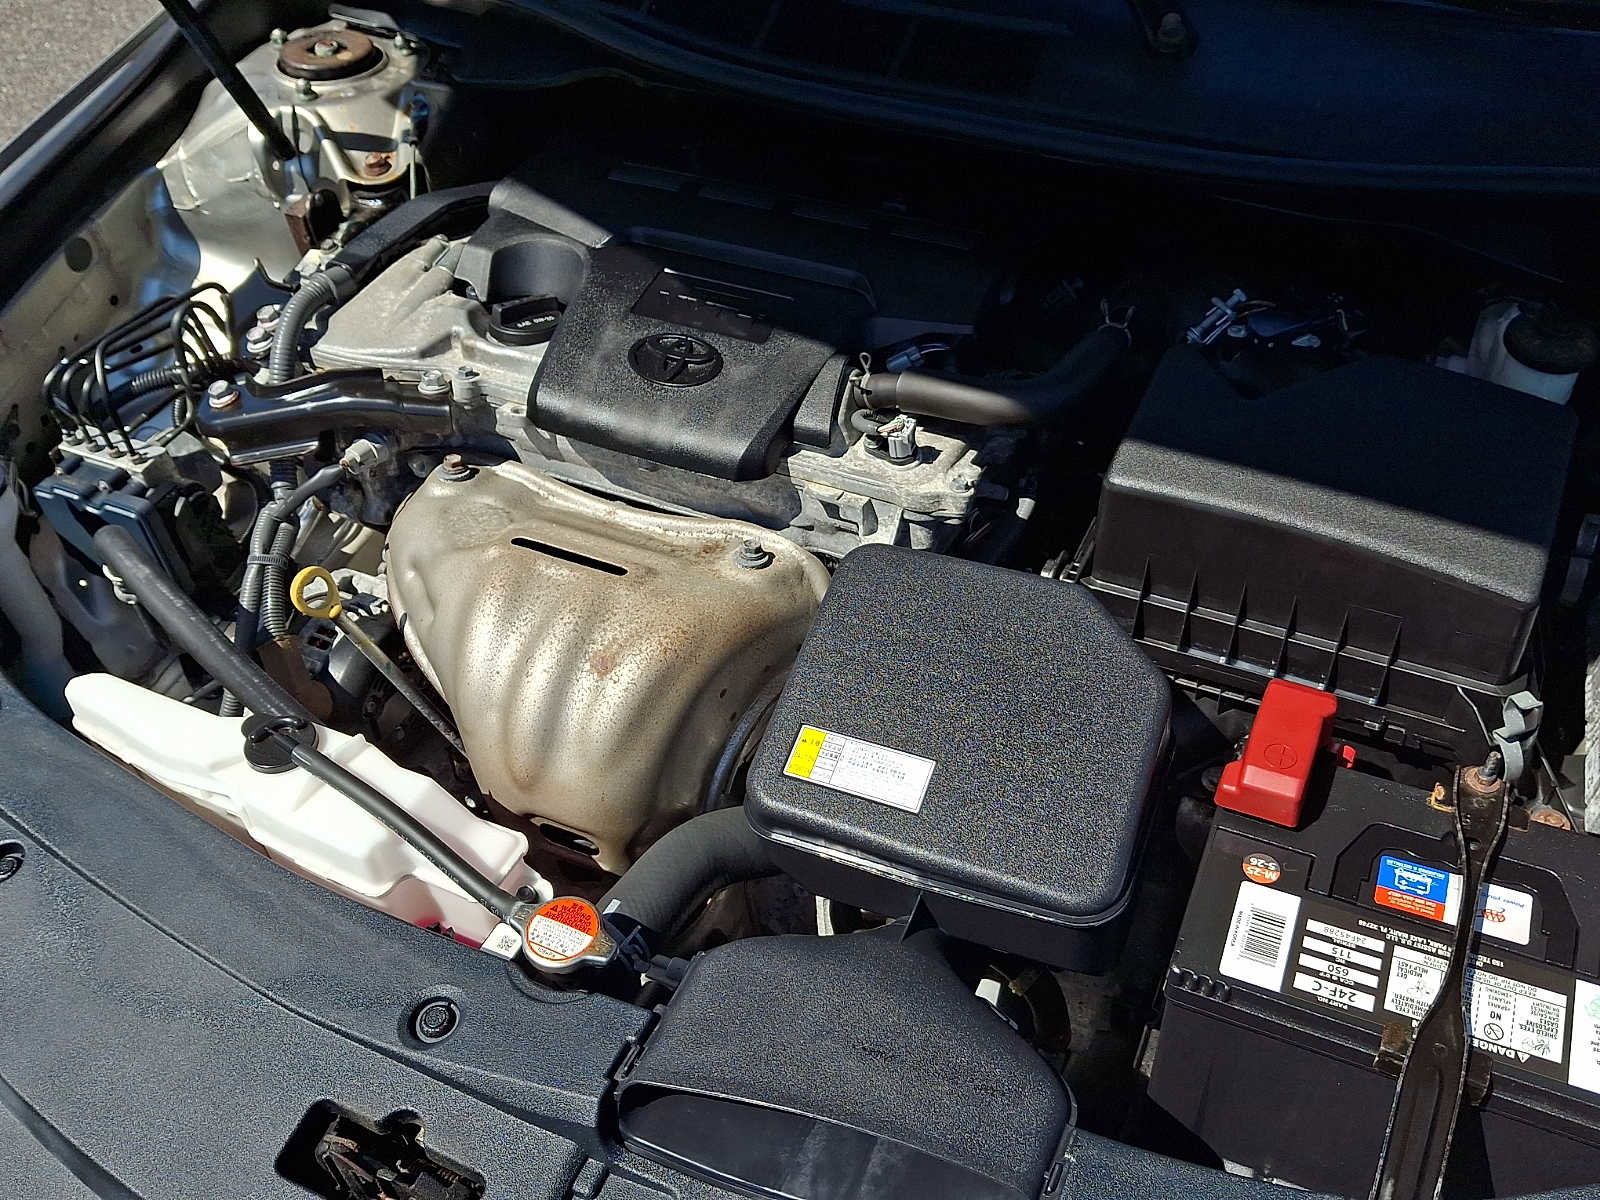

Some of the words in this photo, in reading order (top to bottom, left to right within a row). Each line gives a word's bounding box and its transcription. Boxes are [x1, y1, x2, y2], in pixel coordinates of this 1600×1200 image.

[1248, 856, 1277, 870] S-26
[1245, 864, 1277, 880] M-25
[1330, 946, 1352, 959] 115
[1412, 941, 1436, 953] ASSIST
[1326, 963, 1349, 977] 650
[1396, 966, 1422, 977] MEDICAL
[1311, 979, 1356, 1002] 24F-C
[1489, 1010, 1502, 1020] NO
[1470, 1037, 1516, 1059] DANGE
